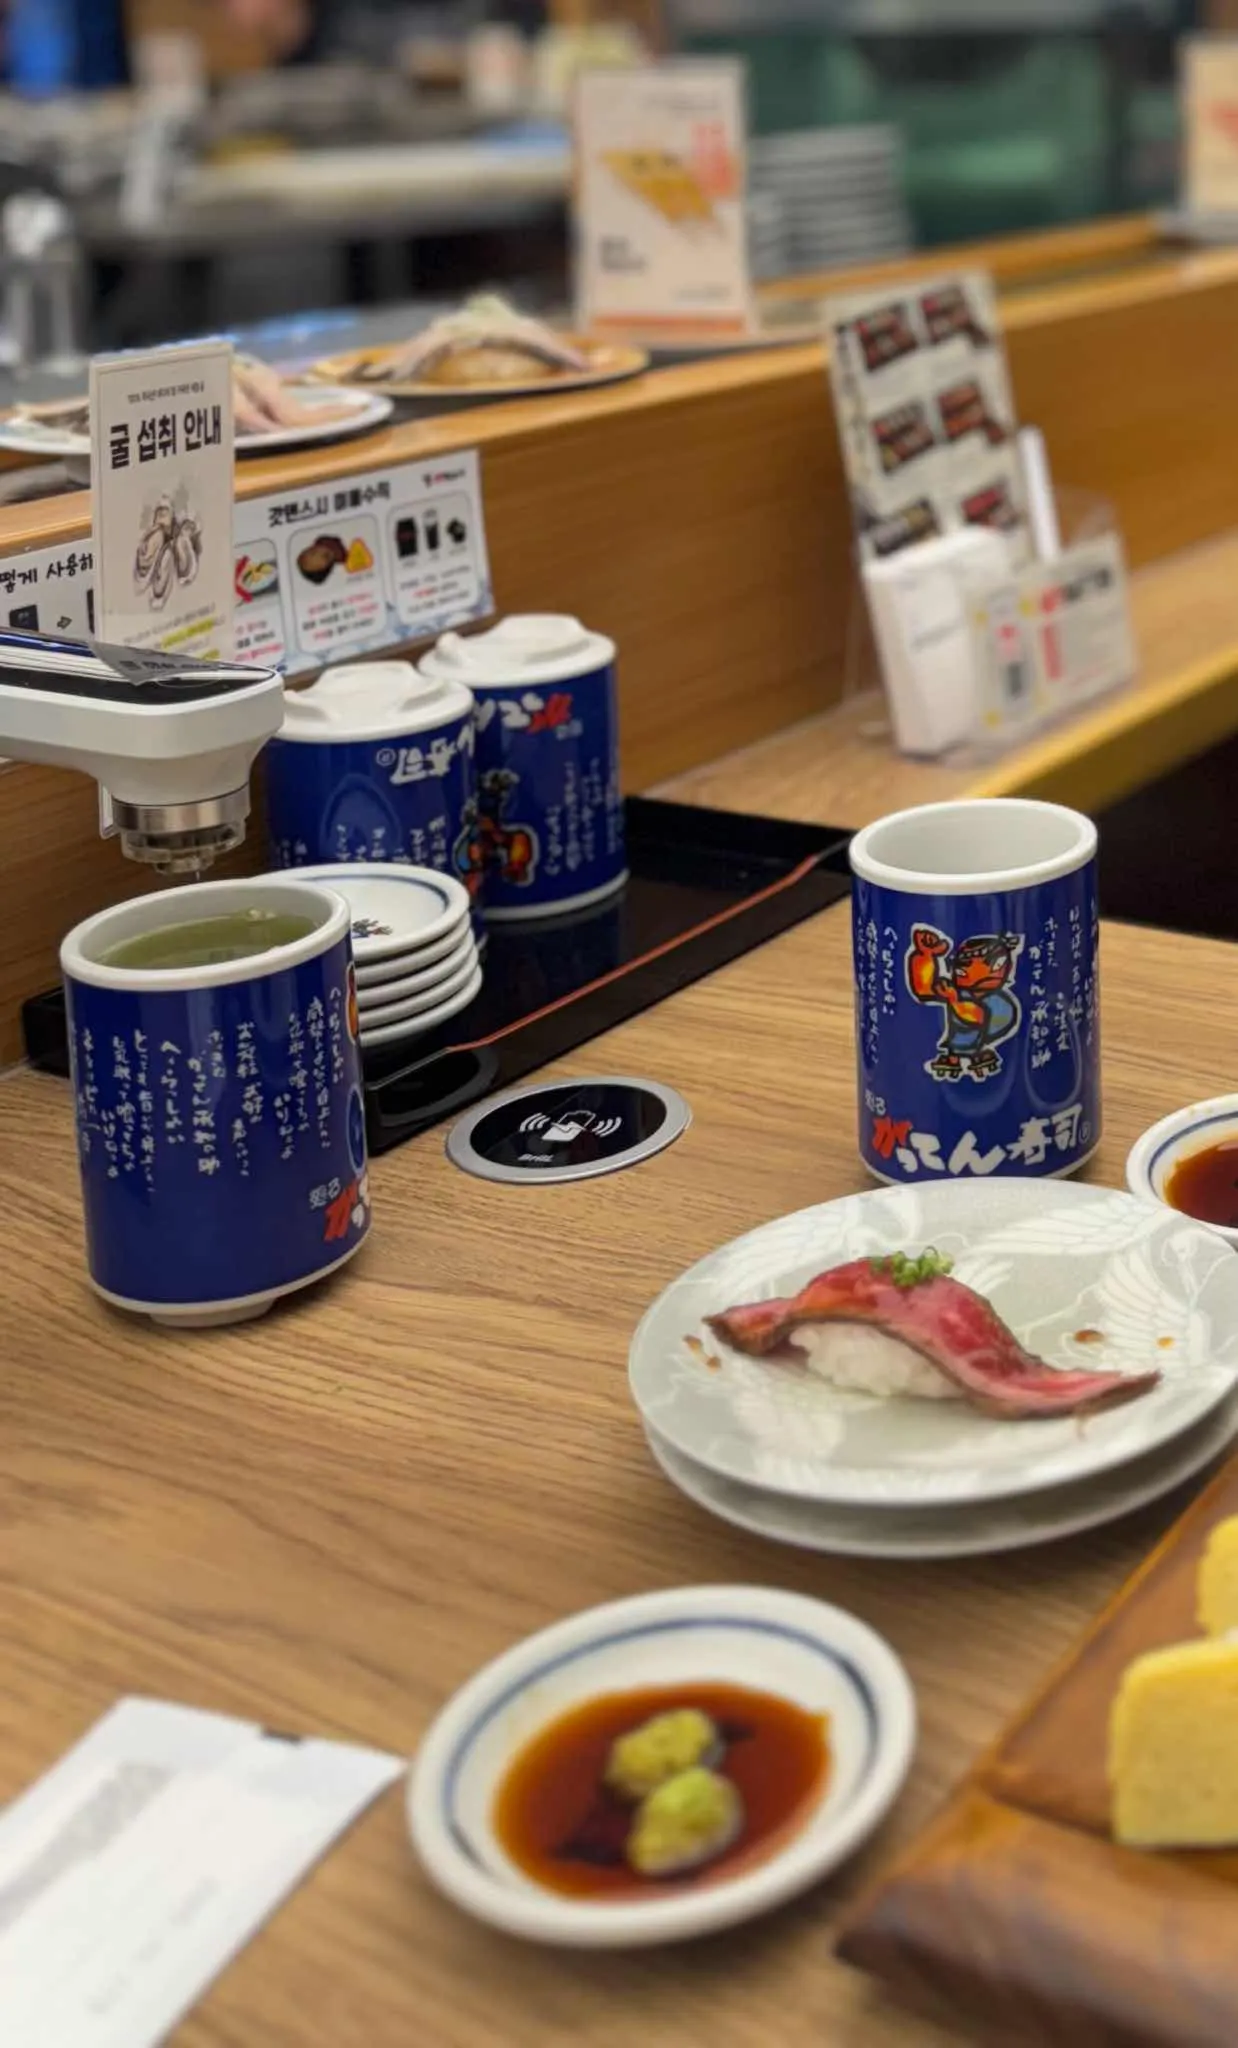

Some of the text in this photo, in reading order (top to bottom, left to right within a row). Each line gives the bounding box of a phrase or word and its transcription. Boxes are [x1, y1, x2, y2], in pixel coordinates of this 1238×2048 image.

[111, 404, 221, 469] 굴 섭취 안내
[872, 1103, 1082, 1176] がってん寿司
